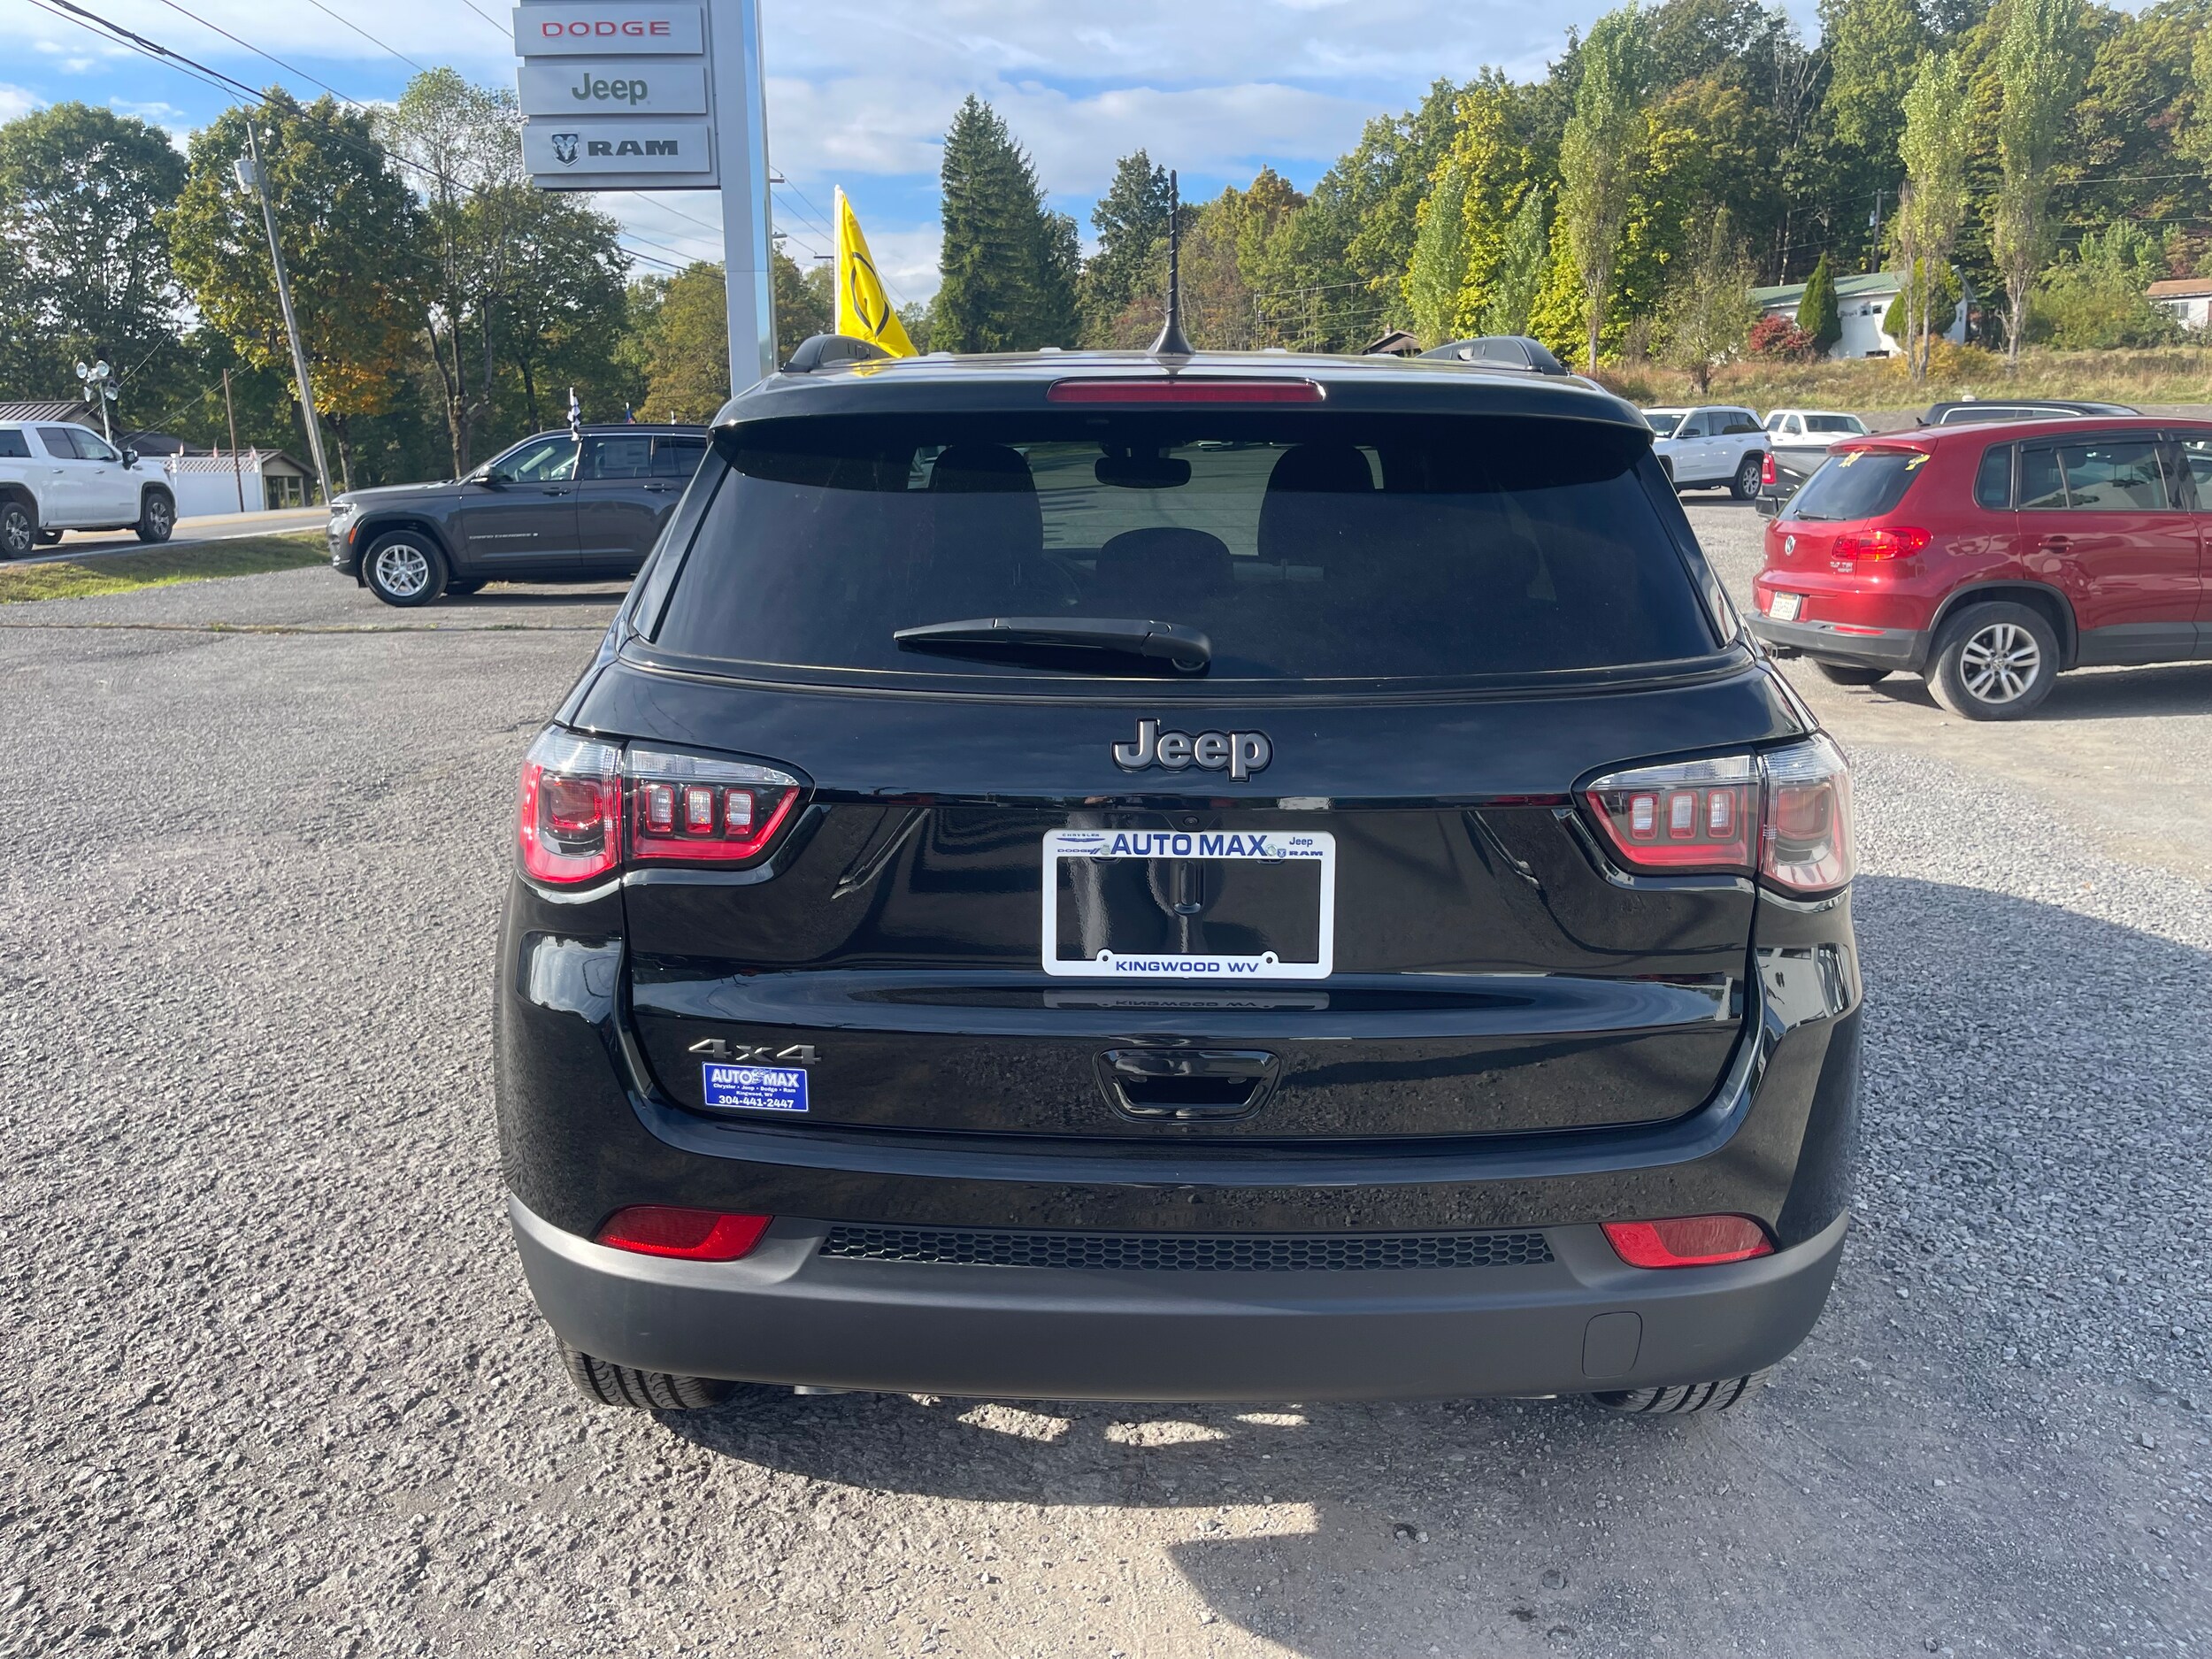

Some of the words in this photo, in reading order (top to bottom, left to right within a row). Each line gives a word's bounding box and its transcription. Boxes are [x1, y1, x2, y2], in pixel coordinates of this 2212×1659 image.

[541, 20, 672, 37] DODGE
[572, 73, 649, 105] Jeep
[588, 140, 679, 156] RAM
[1112, 718, 1272, 781] Jeep
[1110, 833, 1192, 856] AUTO
[1199, 834, 1268, 856] MAX
[1289, 837, 1313, 847] Jeep
[1116, 961, 1220, 972] KINGWOOD
[1227, 962, 1259, 972] WV
[688, 1038, 822, 1064] 4x4
[711, 1068, 753, 1085] AUTO
[763, 1071, 800, 1088] MAX
[718, 1094, 795, 1109] 304-441-2447
